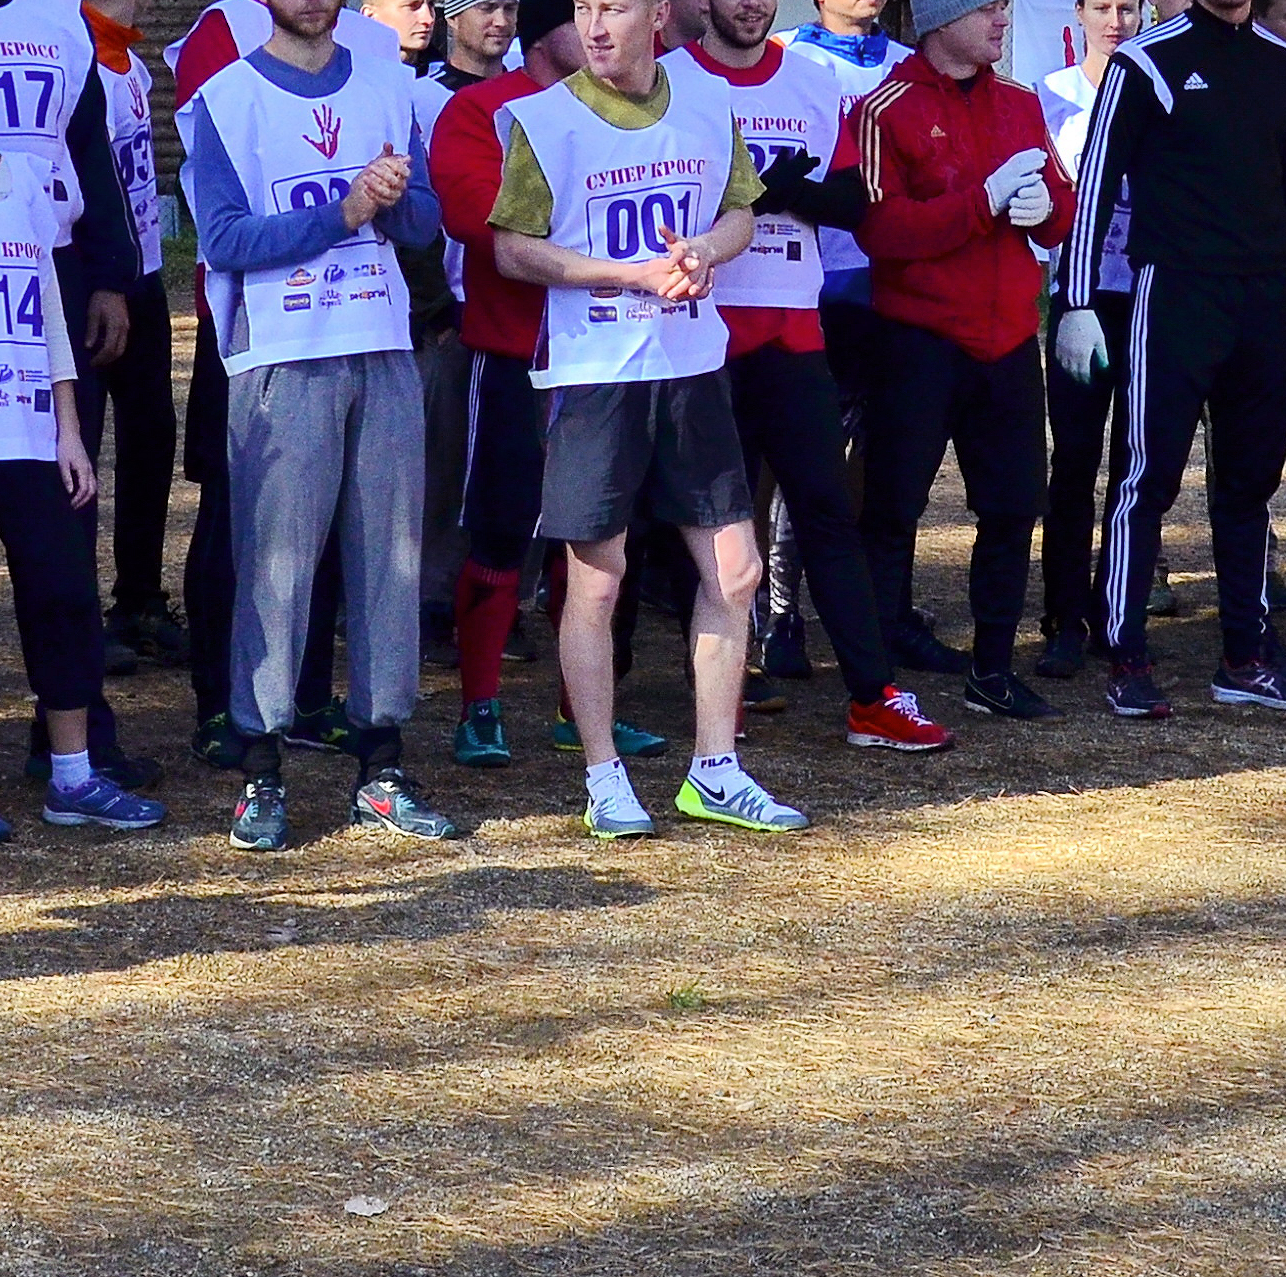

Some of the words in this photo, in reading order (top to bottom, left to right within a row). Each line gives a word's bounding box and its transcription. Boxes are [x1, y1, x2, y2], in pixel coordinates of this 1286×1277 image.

[0, 42, 60, 59] КРОСС
[752, 117, 807, 133] КРОСС
[586, 165, 646, 190] СУПЕР
[651, 159, 706, 177] КРОСС
[607, 191, 691, 259] 001
[701, 756, 733, 769] FILA
